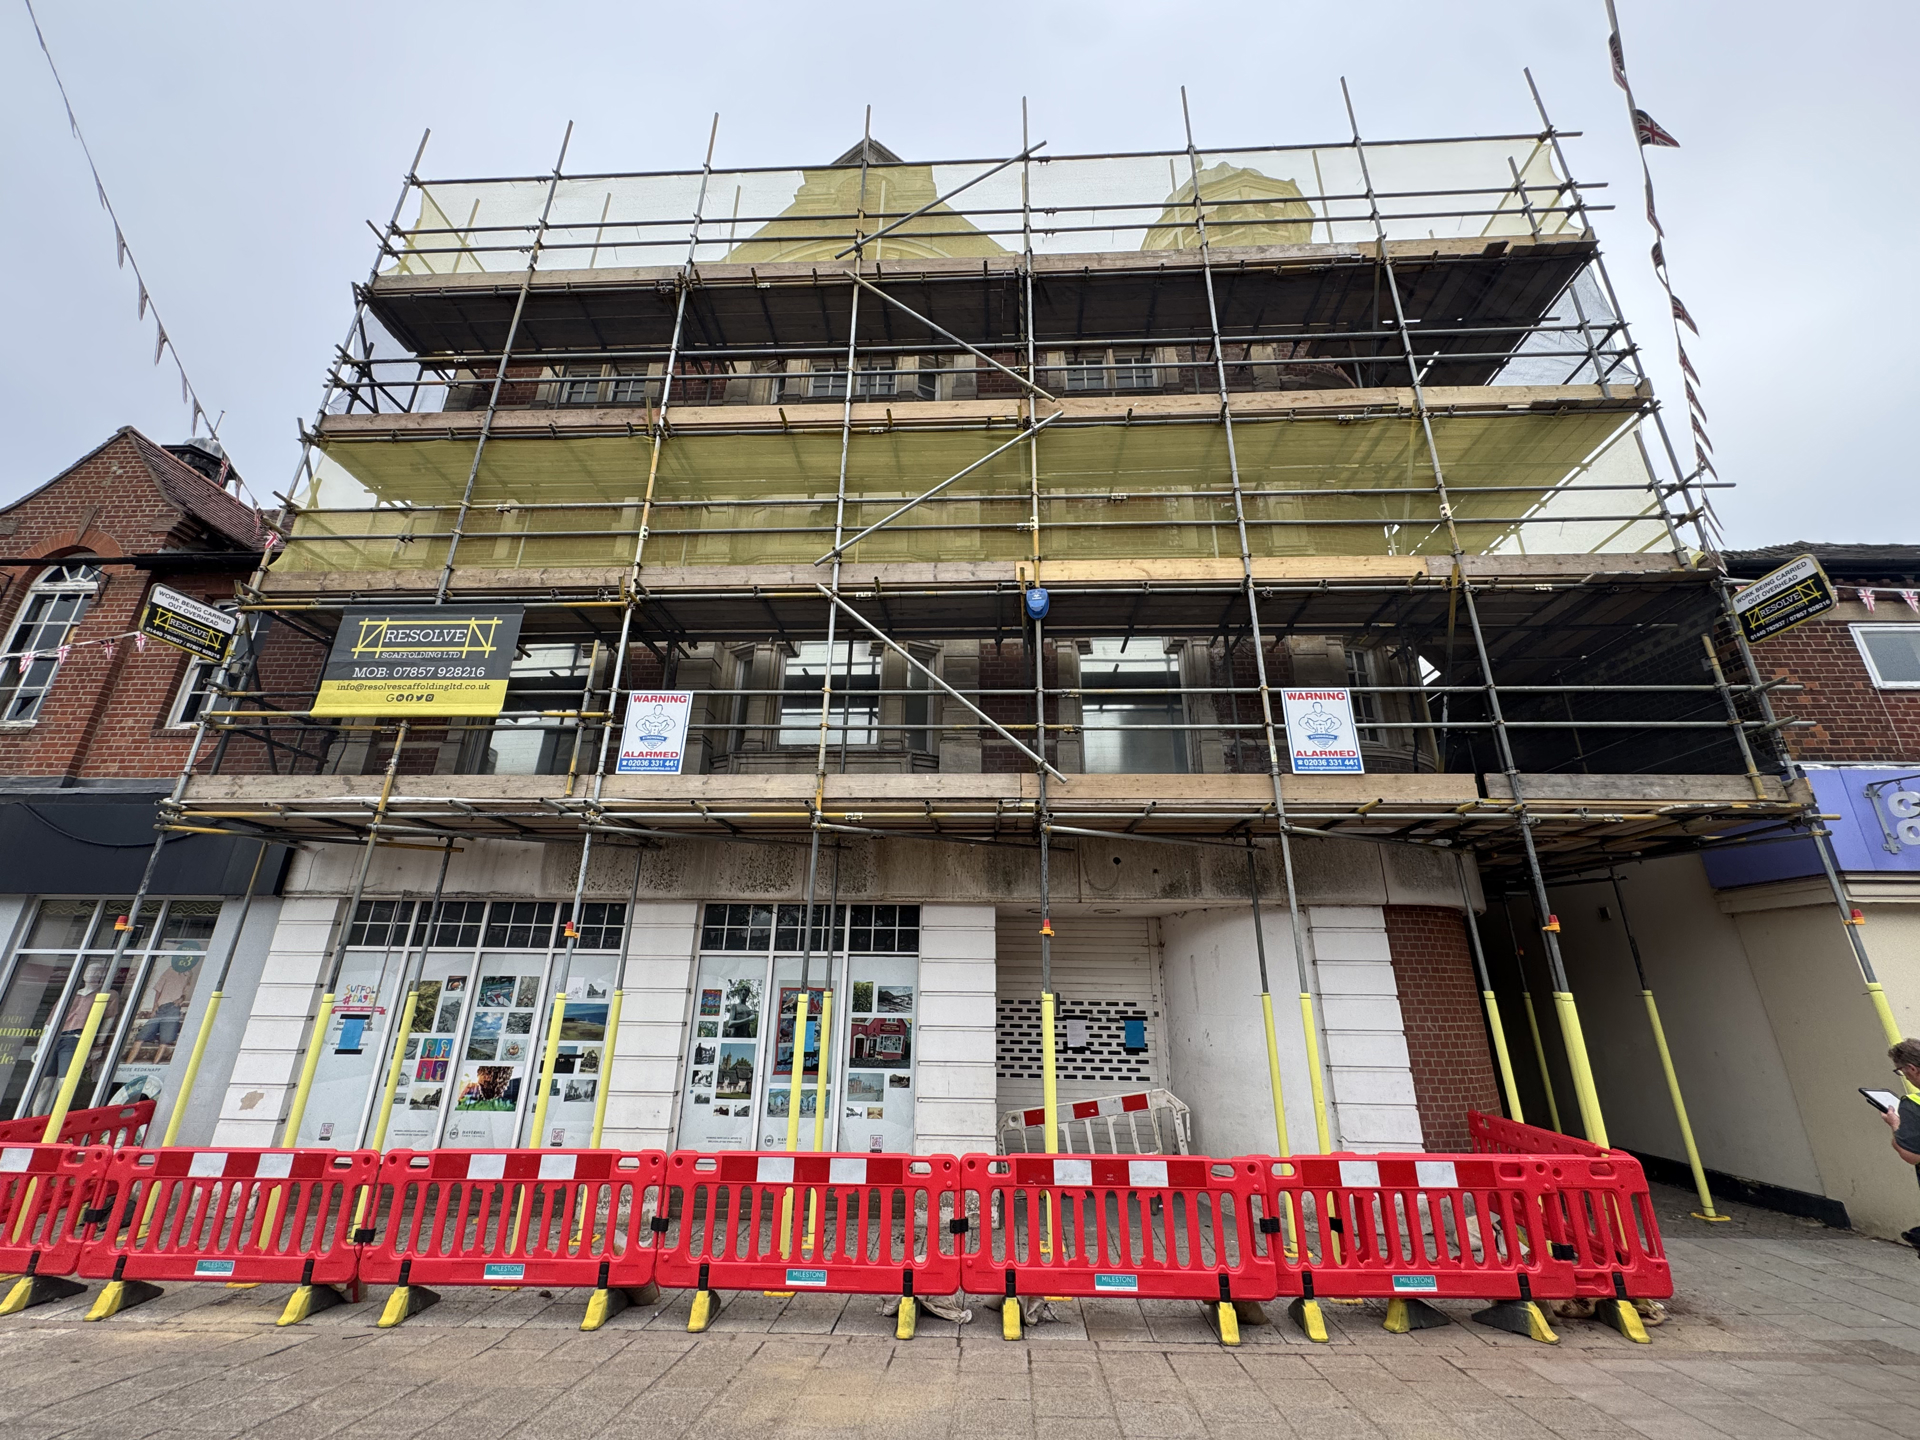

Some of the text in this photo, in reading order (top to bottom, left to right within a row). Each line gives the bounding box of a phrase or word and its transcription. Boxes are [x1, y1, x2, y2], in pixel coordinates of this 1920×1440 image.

[1735, 560, 1807, 605] WORK BEING CARRIED
[1747, 574, 1799, 605] OUT OVERHEAD
[158, 589, 232, 625] WORK BEING CARRIED
[1759, 591, 1802, 618] RESOLVE
[167, 600, 220, 627] OUT OVERHEAD
[168, 617, 209, 639] RESOLVE
[383, 628, 468, 643] RESOLVE
[380, 651, 461, 659] SCAFFOLDING LTD
[352, 666, 486, 678] MOB: 07857 928216
[336, 682, 491, 692] info@resolvescaffoldingltd.co.uk
[633, 694, 688, 704] WARNING
[1286, 692, 1346, 701] WARNING
[623, 750, 679, 758] ALARMED
[628, 759, 678, 767] 02036 331 441
[344, 984, 381, 996] SUFFOL
[0, 1027, 46, 1037] ummer
